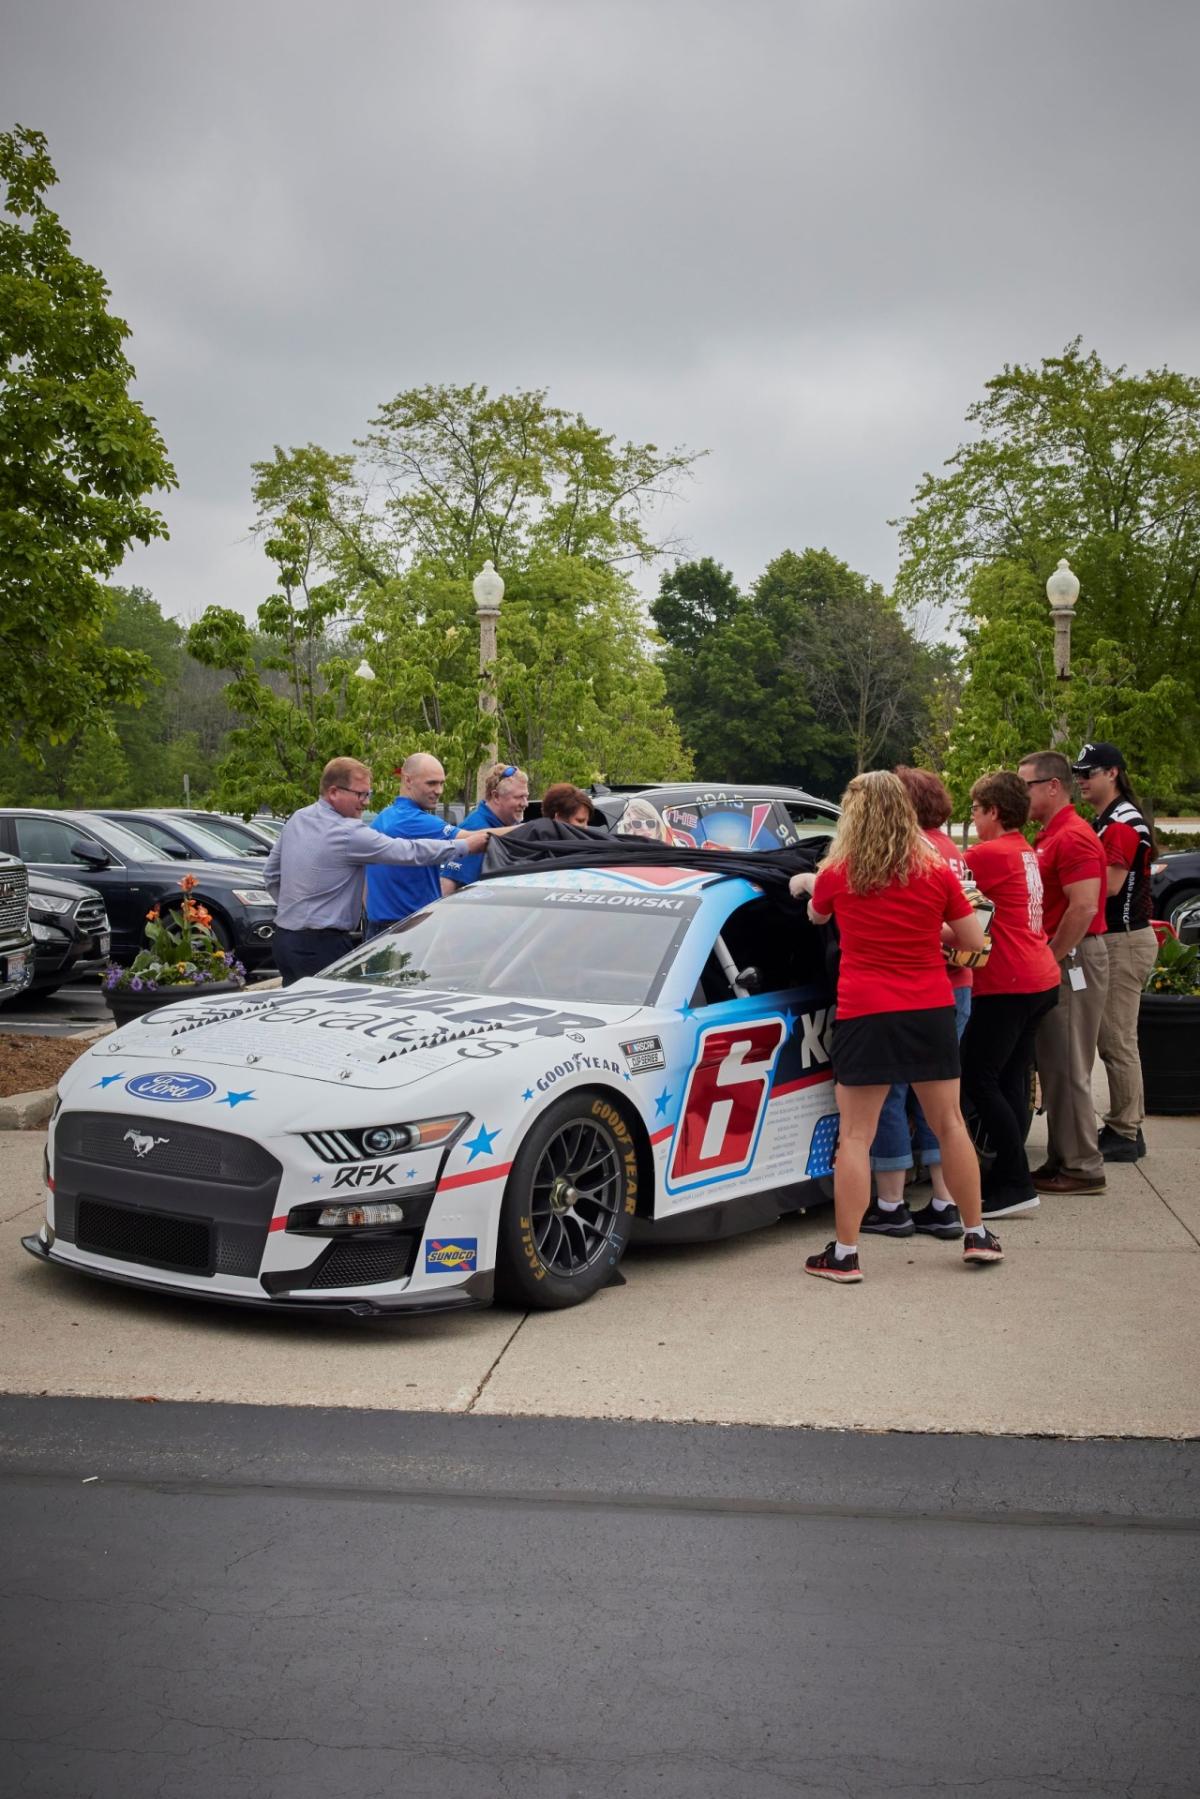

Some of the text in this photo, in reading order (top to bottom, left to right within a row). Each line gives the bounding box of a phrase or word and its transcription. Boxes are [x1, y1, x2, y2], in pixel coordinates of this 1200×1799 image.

[668, 809, 698, 829] THE
[543, 892, 684, 910] KESELOWSKI
[138, 1075, 200, 1098] Ford
[671, 1023, 783, 1179] 6
[331, 1163, 399, 1188] RFK
[428, 1250, 475, 1262] SUNOCO
[519, 1216, 546, 1281] EAGLE
